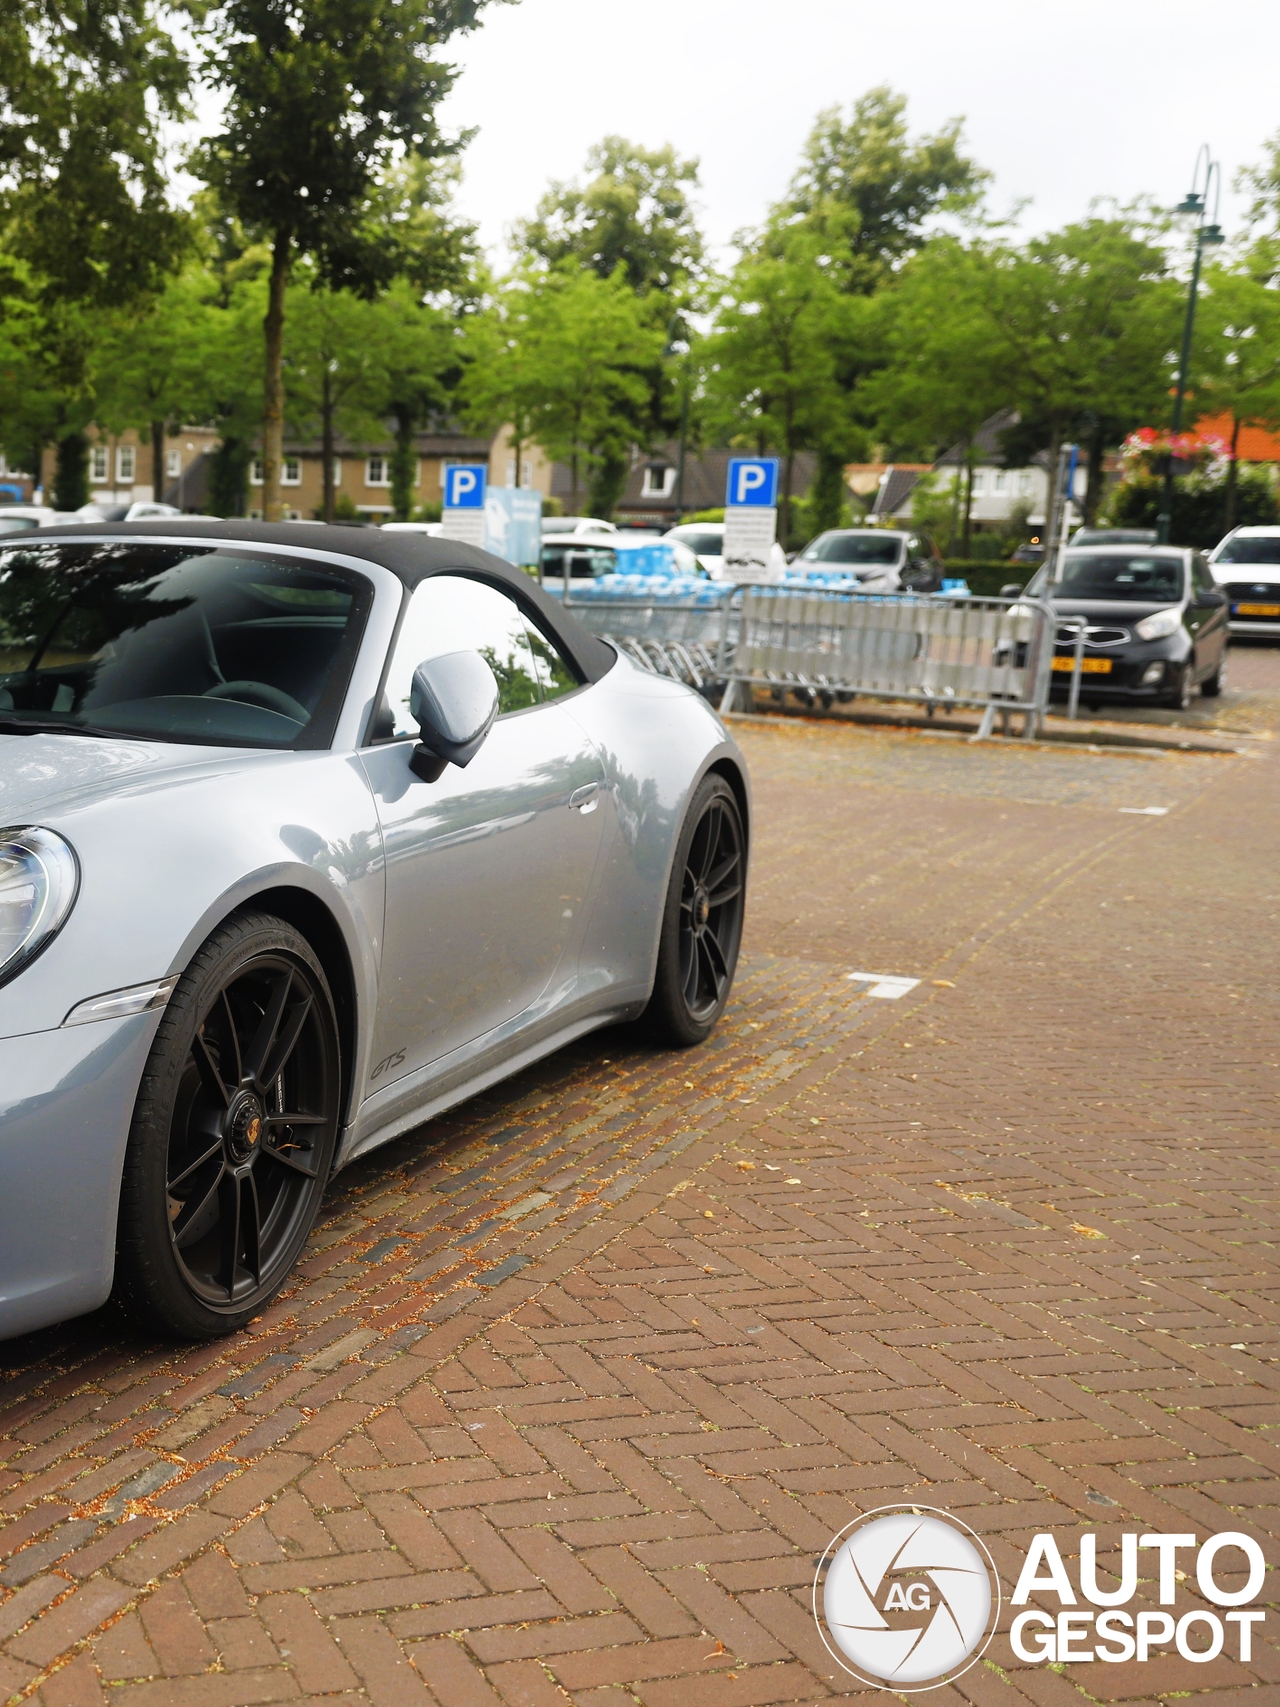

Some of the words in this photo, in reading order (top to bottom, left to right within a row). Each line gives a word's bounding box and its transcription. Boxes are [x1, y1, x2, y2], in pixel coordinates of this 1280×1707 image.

[452, 470, 477, 505] P
[737, 464, 766, 502] P
[371, 1047, 407, 1080] GTS
